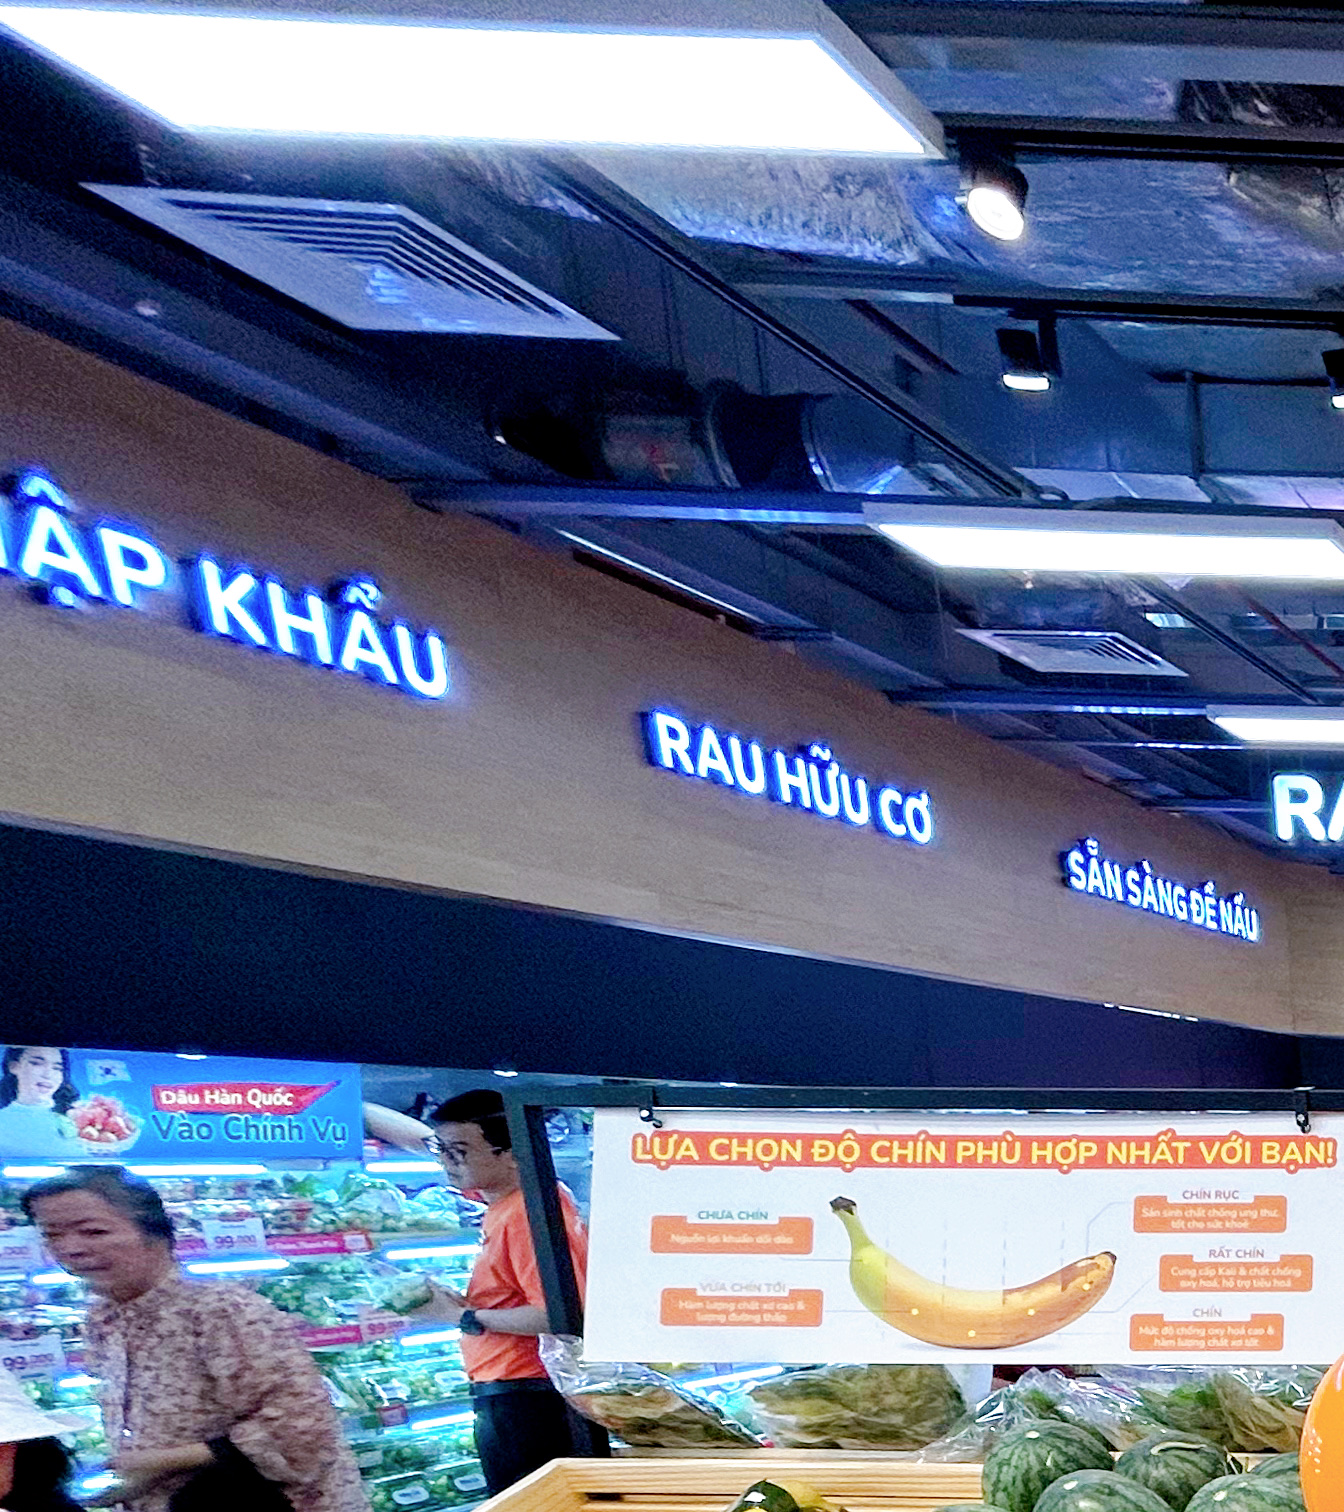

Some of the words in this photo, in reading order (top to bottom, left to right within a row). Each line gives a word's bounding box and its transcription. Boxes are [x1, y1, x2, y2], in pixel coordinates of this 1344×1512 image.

[0, 474, 167, 608] ẬP
[200, 559, 449, 698] KHẨU
[654, 711, 766, 795] RAU
[774, 742, 870, 826] HỮU
[879, 787, 933, 845] CƠ
[1125, 859, 1188, 922] SÀNG
[161, 1086, 202, 1105] Dâu
[207, 1086, 243, 1105] Hàn
[247, 1087, 295, 1109] Quốc
[152, 1111, 215, 1143] Vào
[223, 1112, 302, 1143] Chính
[312, 1116, 350, 1150] Vụ
[634, 1134, 700, 1168] LỰA
[708, 1137, 802, 1168] CHỌN
[811, 1132, 861, 1169] ĐỘ
[869, 1134, 946, 1164] CHÍN
[956, 1135, 1021, 1165] PHÙ
[1031, 1137, 1097, 1171] HỢP
[1107, 1131, 1189, 1165] NHẤT
[1197, 1133, 1251, 1165] VỚI
[1261, 1141, 1335, 1171] BẠN!
[1182, 1187, 1212, 1200] CHÍN
[1214, 1189, 1240, 1201] RỤC
[697, 1210, 735, 1221] CHƯA
[737, 1207, 769, 1221] CHÍN
[1208, 1245, 1233, 1259] RẤT
[1235, 1246, 1265, 1259] CHÍN
[730, 1281, 761, 1293] CHÍN
[1192, 1305, 1223, 1318] CHÍN
